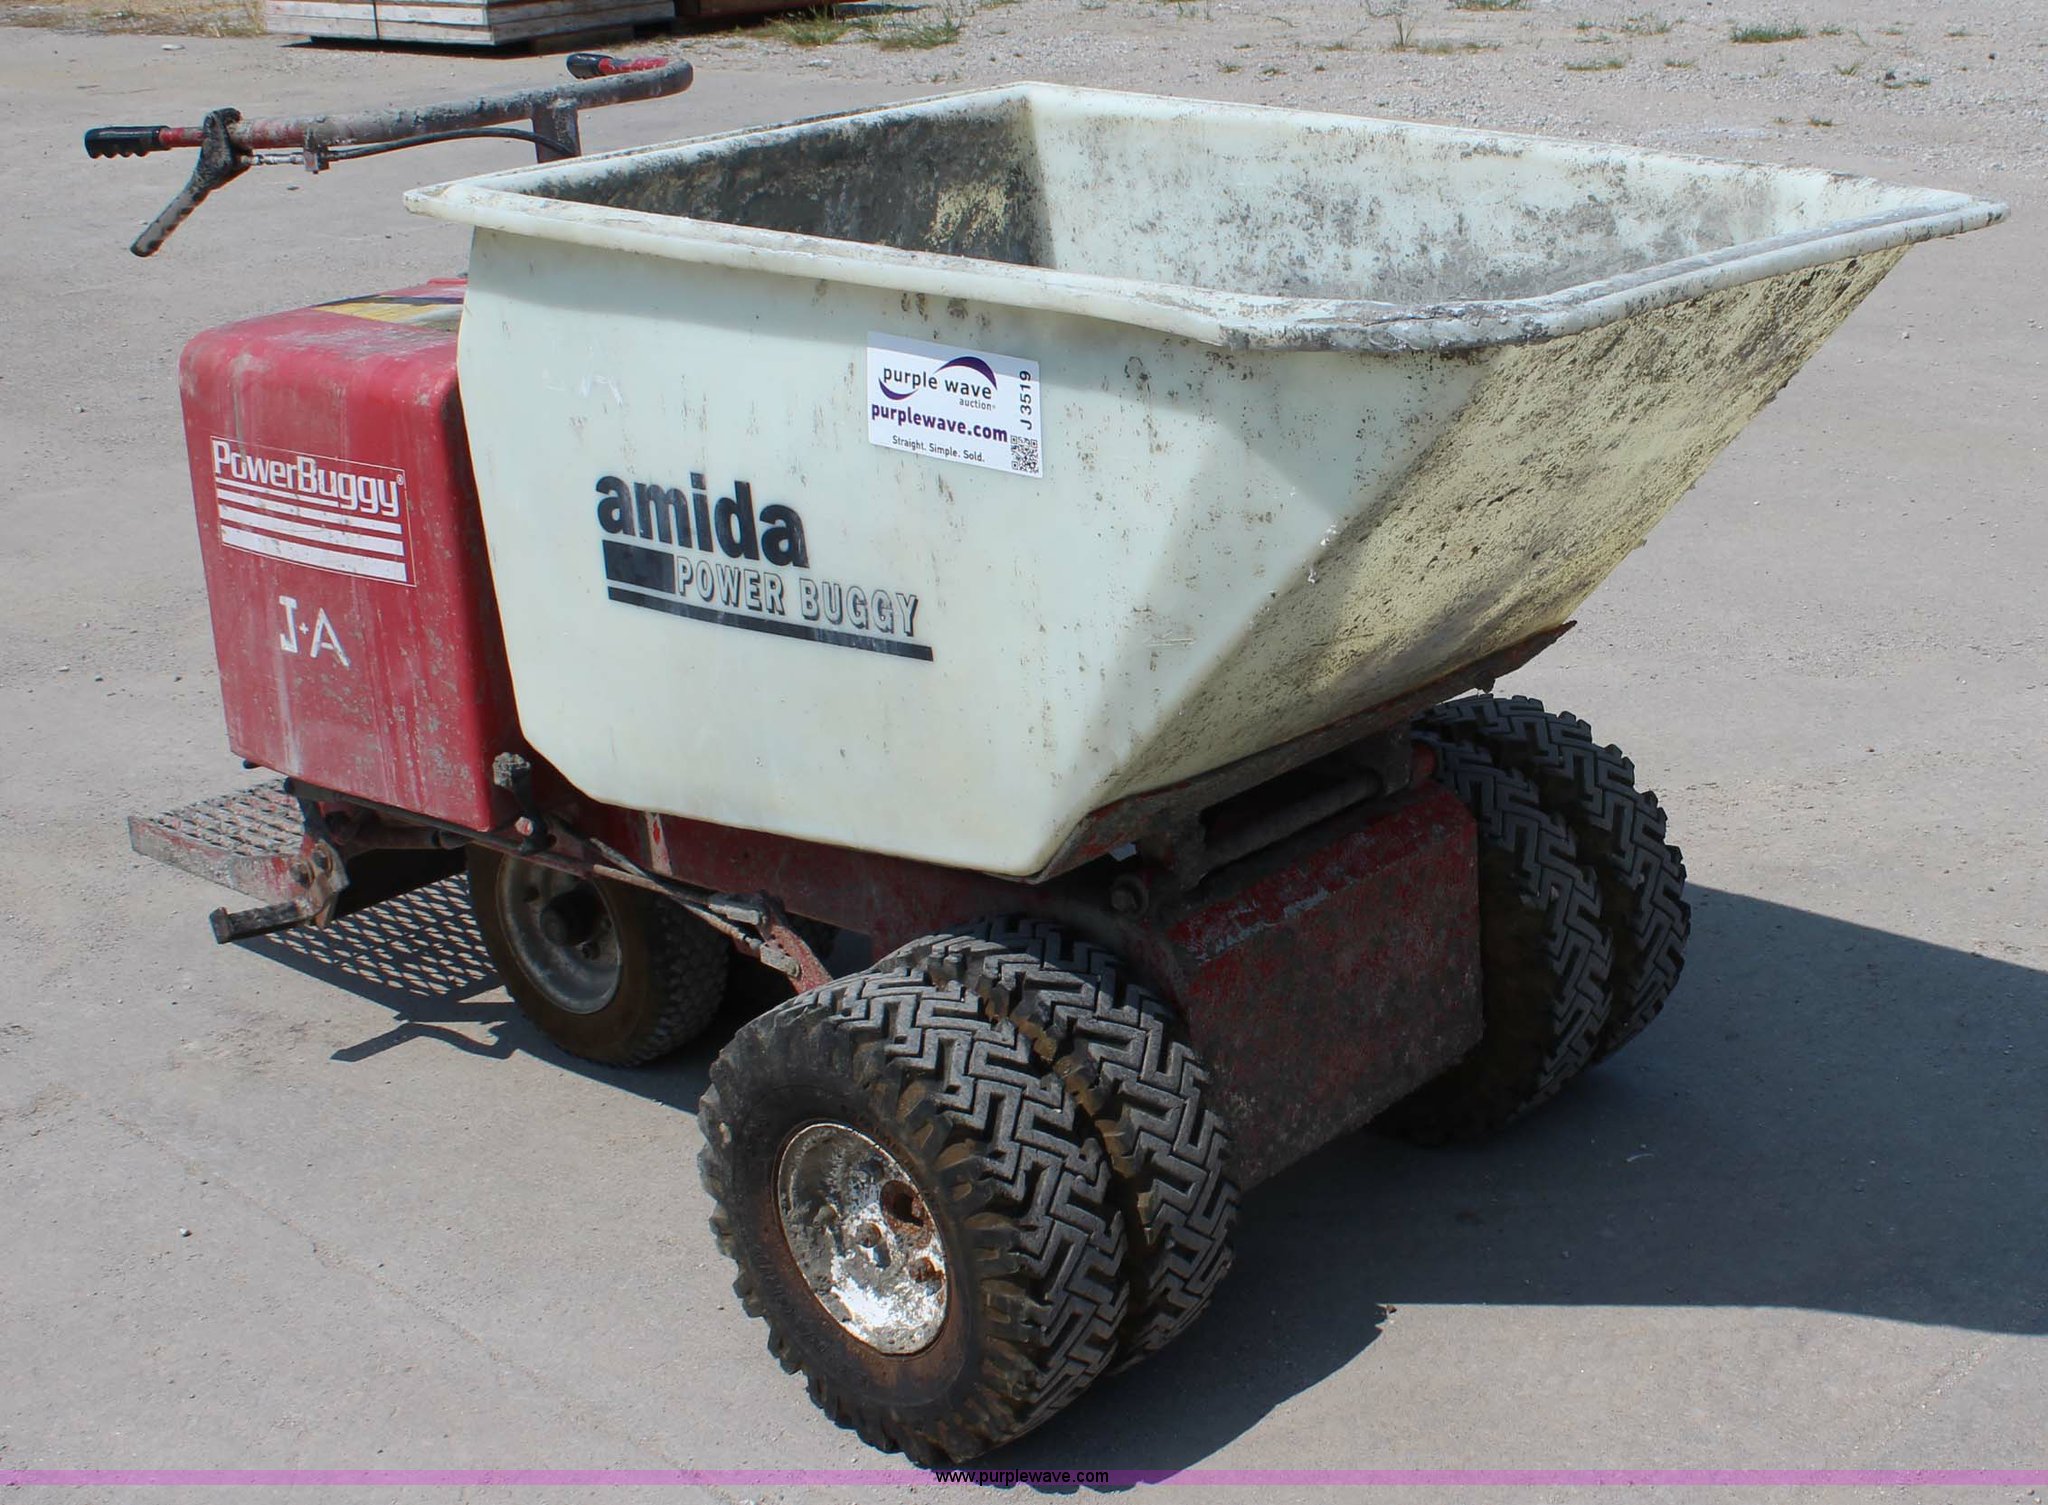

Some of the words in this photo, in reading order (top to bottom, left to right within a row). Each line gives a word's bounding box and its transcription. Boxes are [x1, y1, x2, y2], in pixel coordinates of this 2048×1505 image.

[883, 367, 938, 389] purple
[945, 379, 992, 399] wave
[871, 403, 1008, 443] purplewave.com
[959, 398, 992, 411] auction
[892, 434, 927, 451] Straight.
[929, 443, 961, 458] Simple.
[963, 451, 985, 462] Sold.
[212, 439, 400, 518] PowerBuggy
[595, 472, 809, 569] amida
[676, 556, 786, 616] POWER
[801, 578, 919, 637] BUGGY
